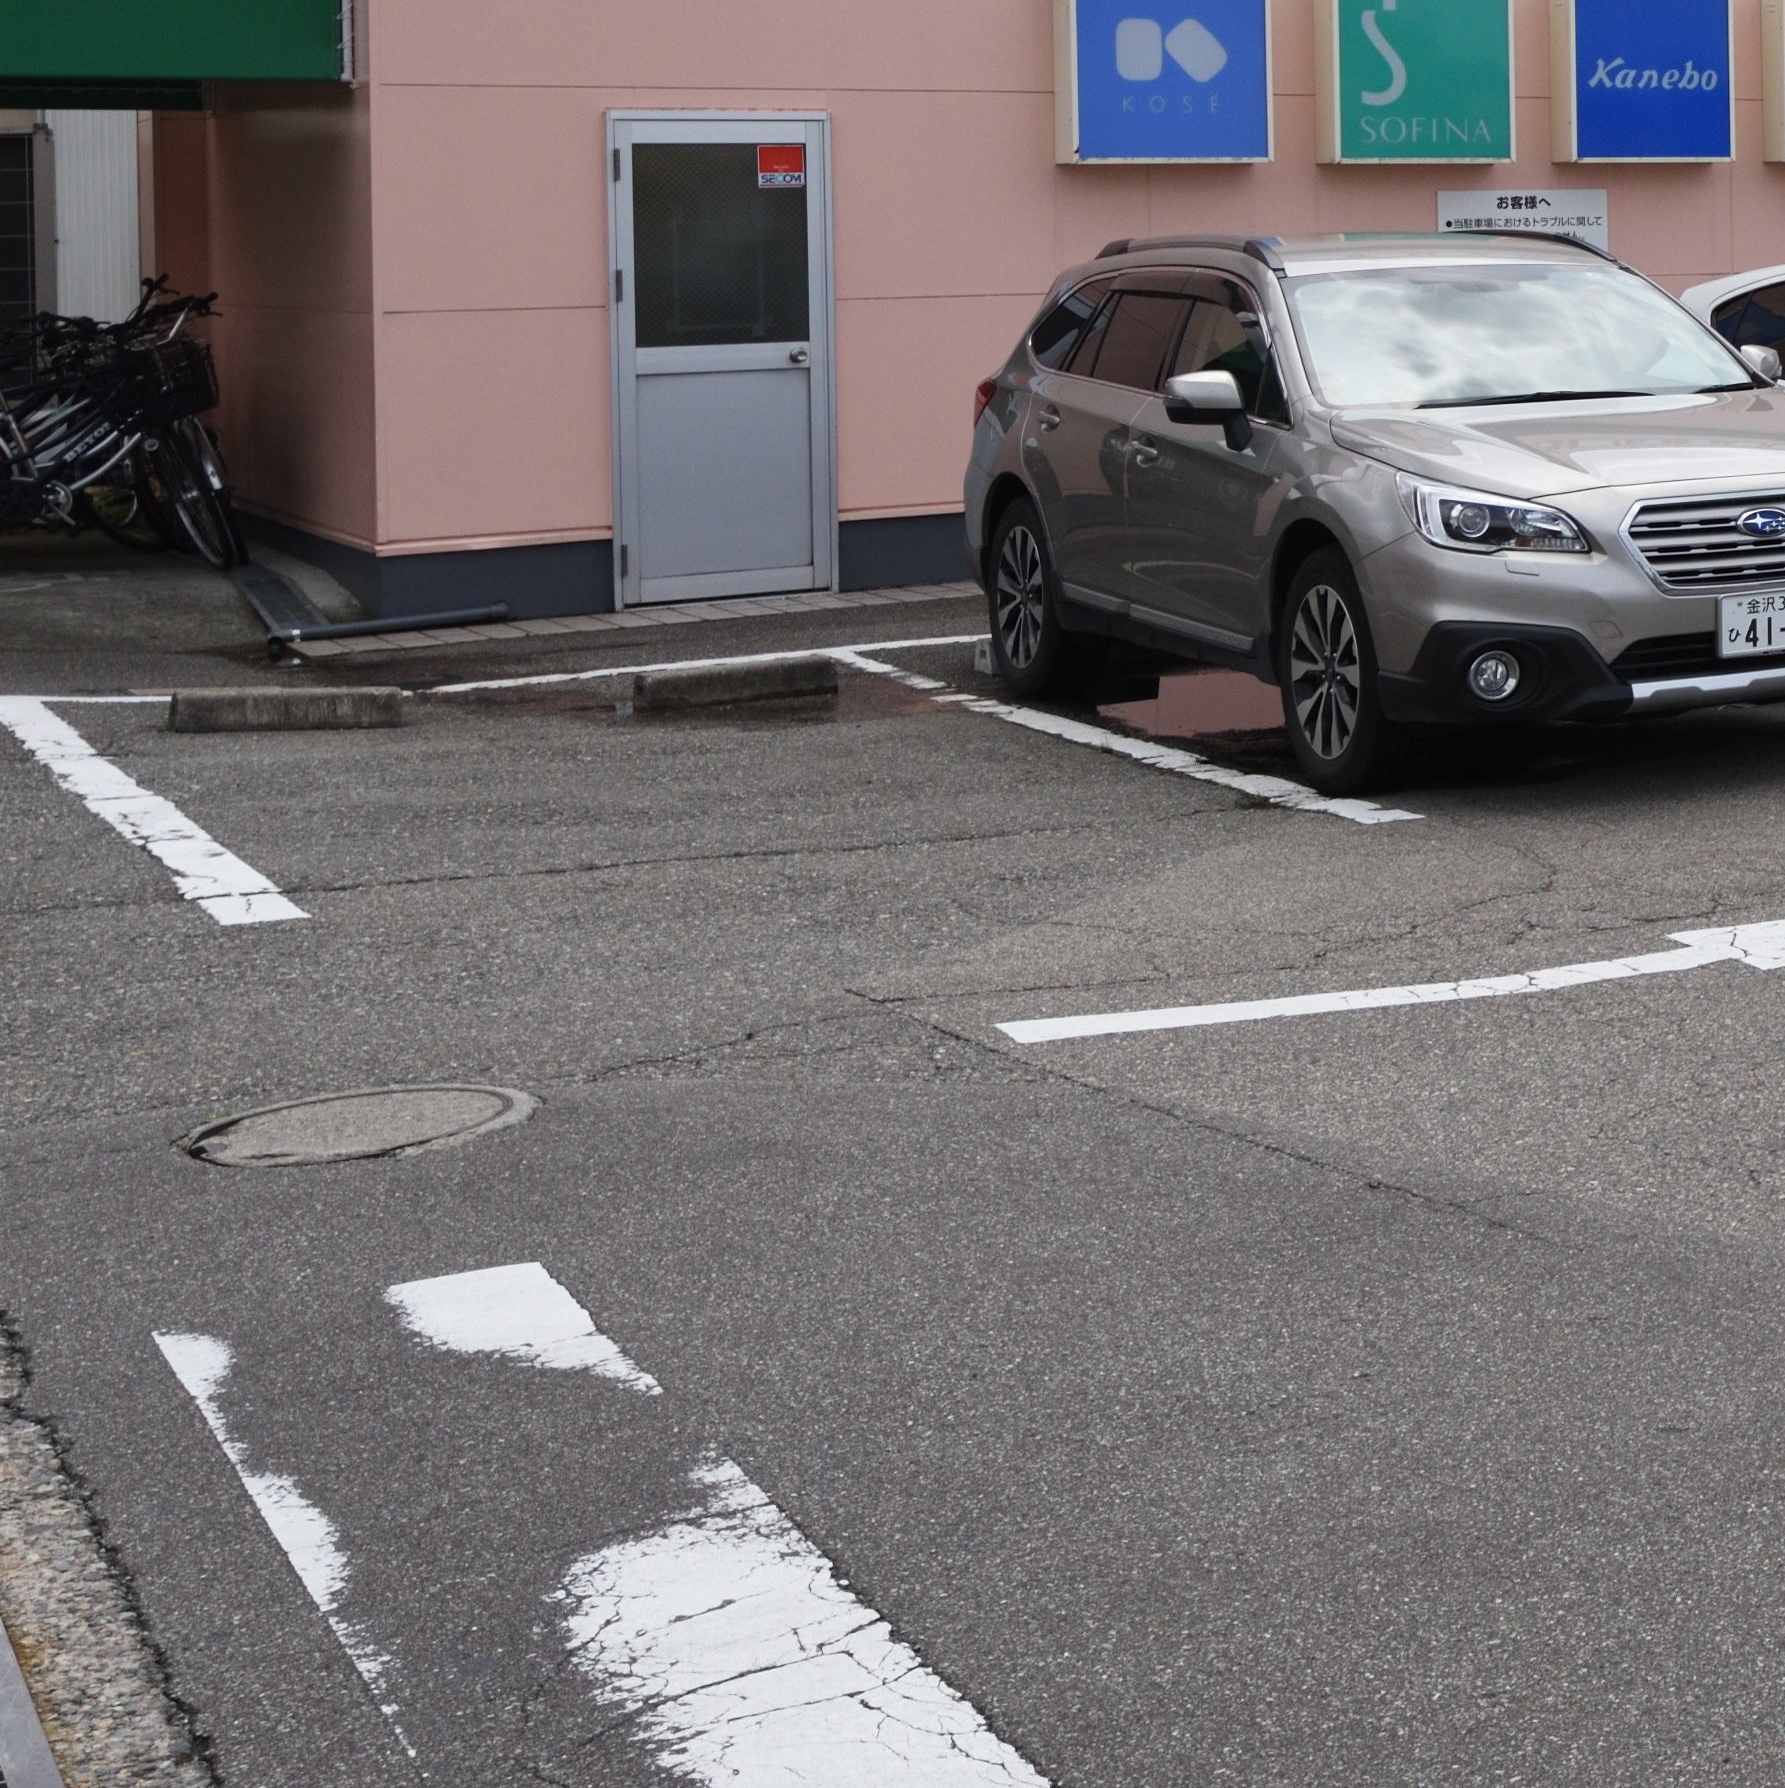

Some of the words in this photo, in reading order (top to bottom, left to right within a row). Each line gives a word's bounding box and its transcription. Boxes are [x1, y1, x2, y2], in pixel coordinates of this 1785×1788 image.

[1589, 58, 1719, 92] Kanebo
[1361, 116, 1492, 145] SOFINA
[760, 173, 802, 184] SECOM
[1496, 195, 1551, 210] お客様へ
[1453, 216, 1602, 229] 当駐車場におけるトラブルに関して
[1728, 628, 1741, 643] ひ
